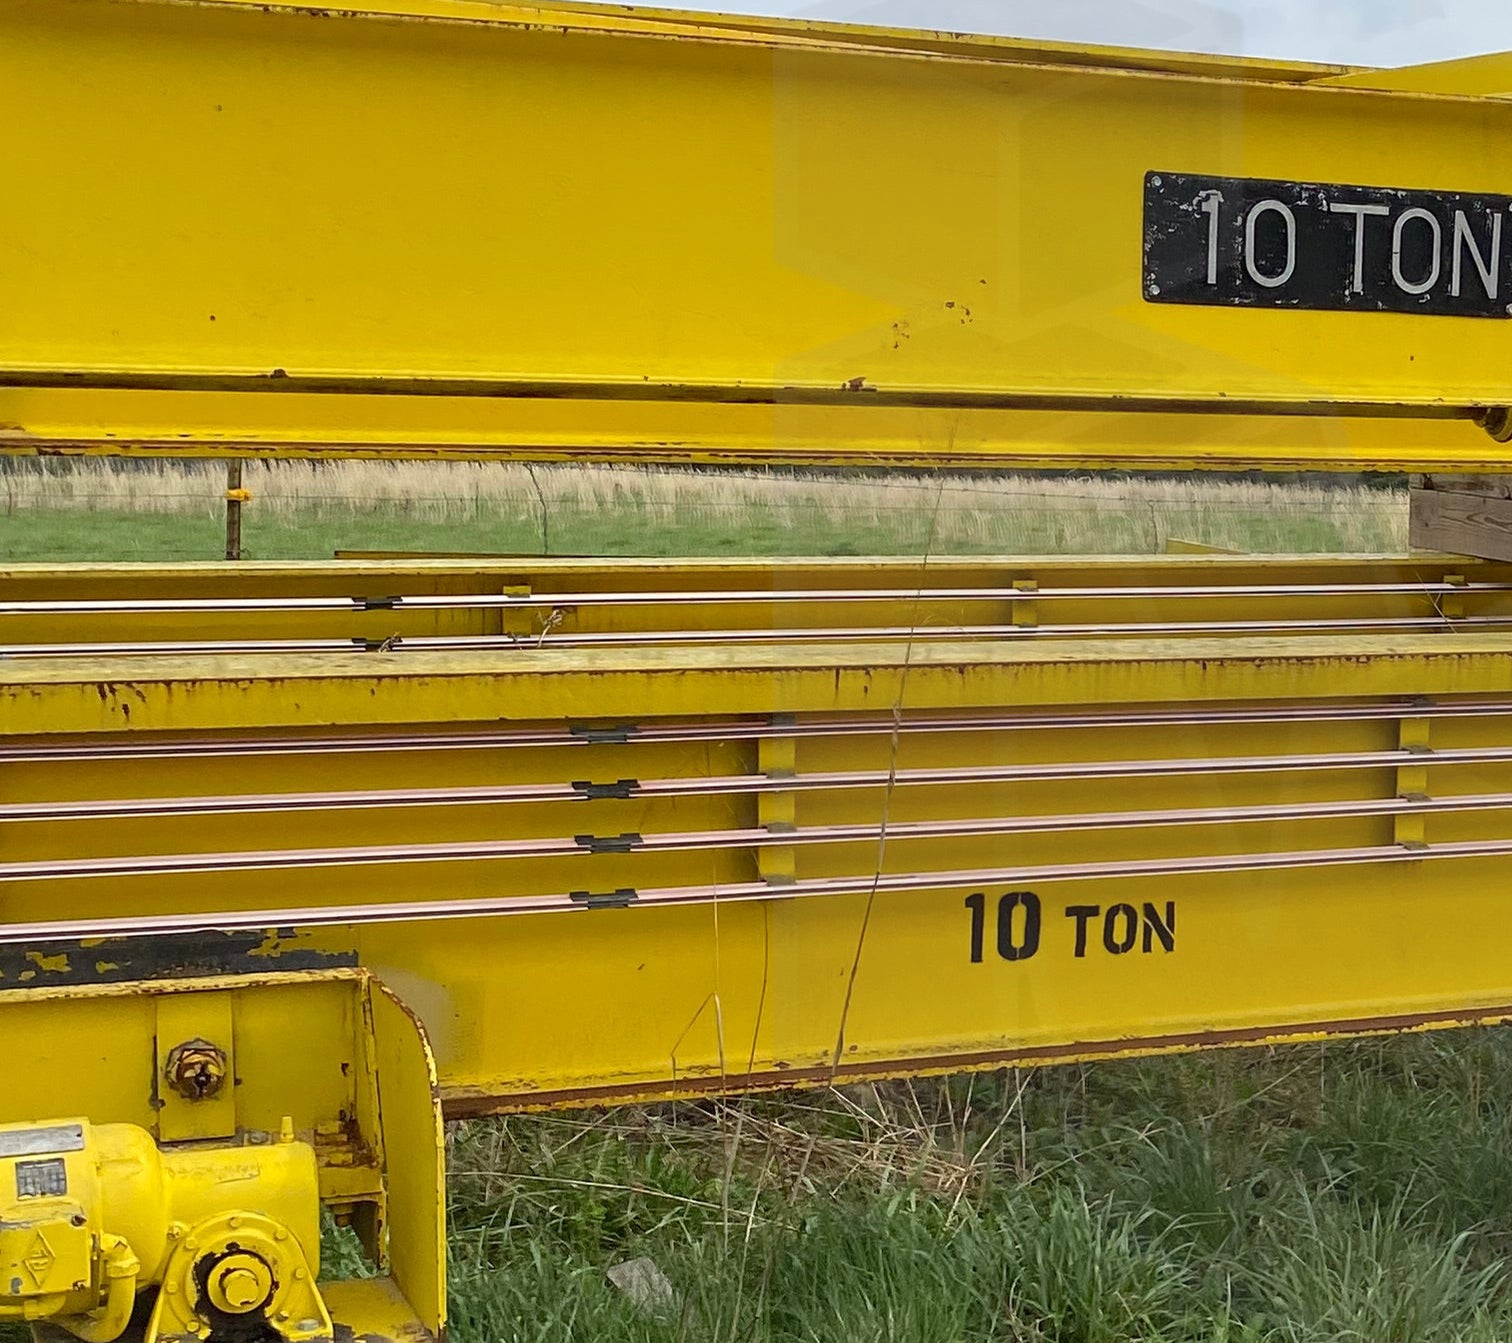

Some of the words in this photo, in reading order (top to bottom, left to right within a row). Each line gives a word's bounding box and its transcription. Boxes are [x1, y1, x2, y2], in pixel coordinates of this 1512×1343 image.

[1200, 191, 1297, 288] 10
[1329, 202, 1502, 299] TON
[964, 891, 1042, 963] 10
[1064, 901, 1176, 958] TON
